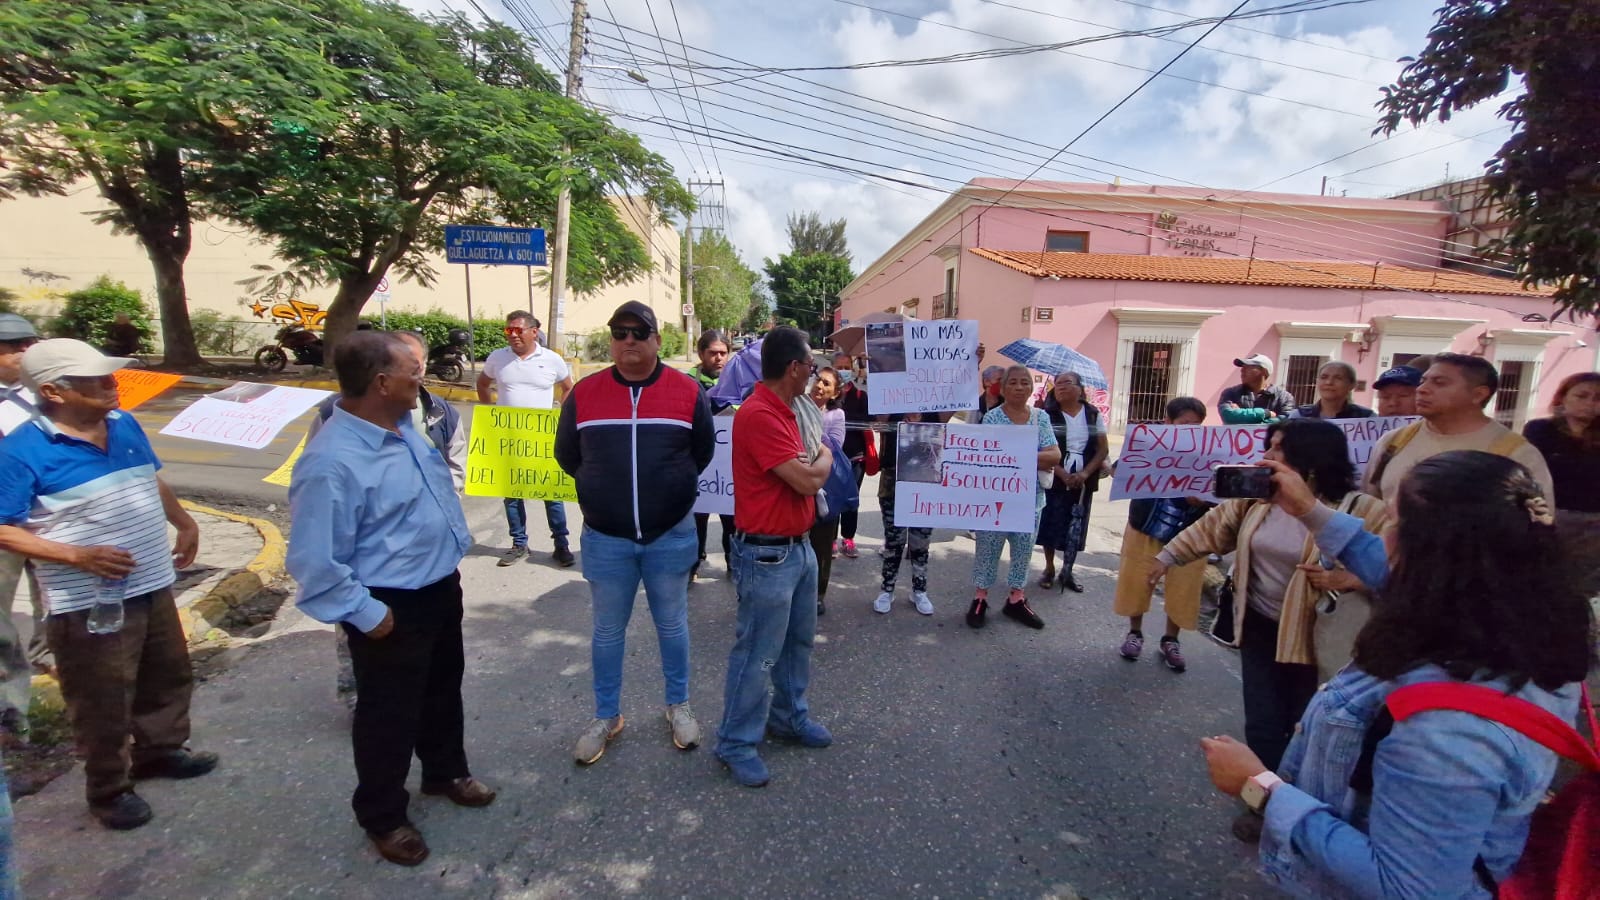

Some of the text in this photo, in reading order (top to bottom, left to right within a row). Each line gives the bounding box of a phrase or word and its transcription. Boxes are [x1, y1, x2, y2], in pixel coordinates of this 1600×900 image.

[461, 230, 531, 244] ESTACIONAMIENTO
[448, 246, 545, 262] GUELAGUETZA A 600 m
[911, 321, 963, 340] NO MÁS
[914, 346, 970, 361] EXCUSAS
[907, 363, 972, 385] SOLUCIÓN
[882, 385, 956, 406] INMEDIATA
[469, 437, 553, 459] AL PROBLE
[950, 433, 1001, 449] FOCO DE
[470, 466, 572, 487] DEL DRENAJE
[528, 489, 548, 499] CASA
[910, 493, 1004, 526] INMEDIATA!
